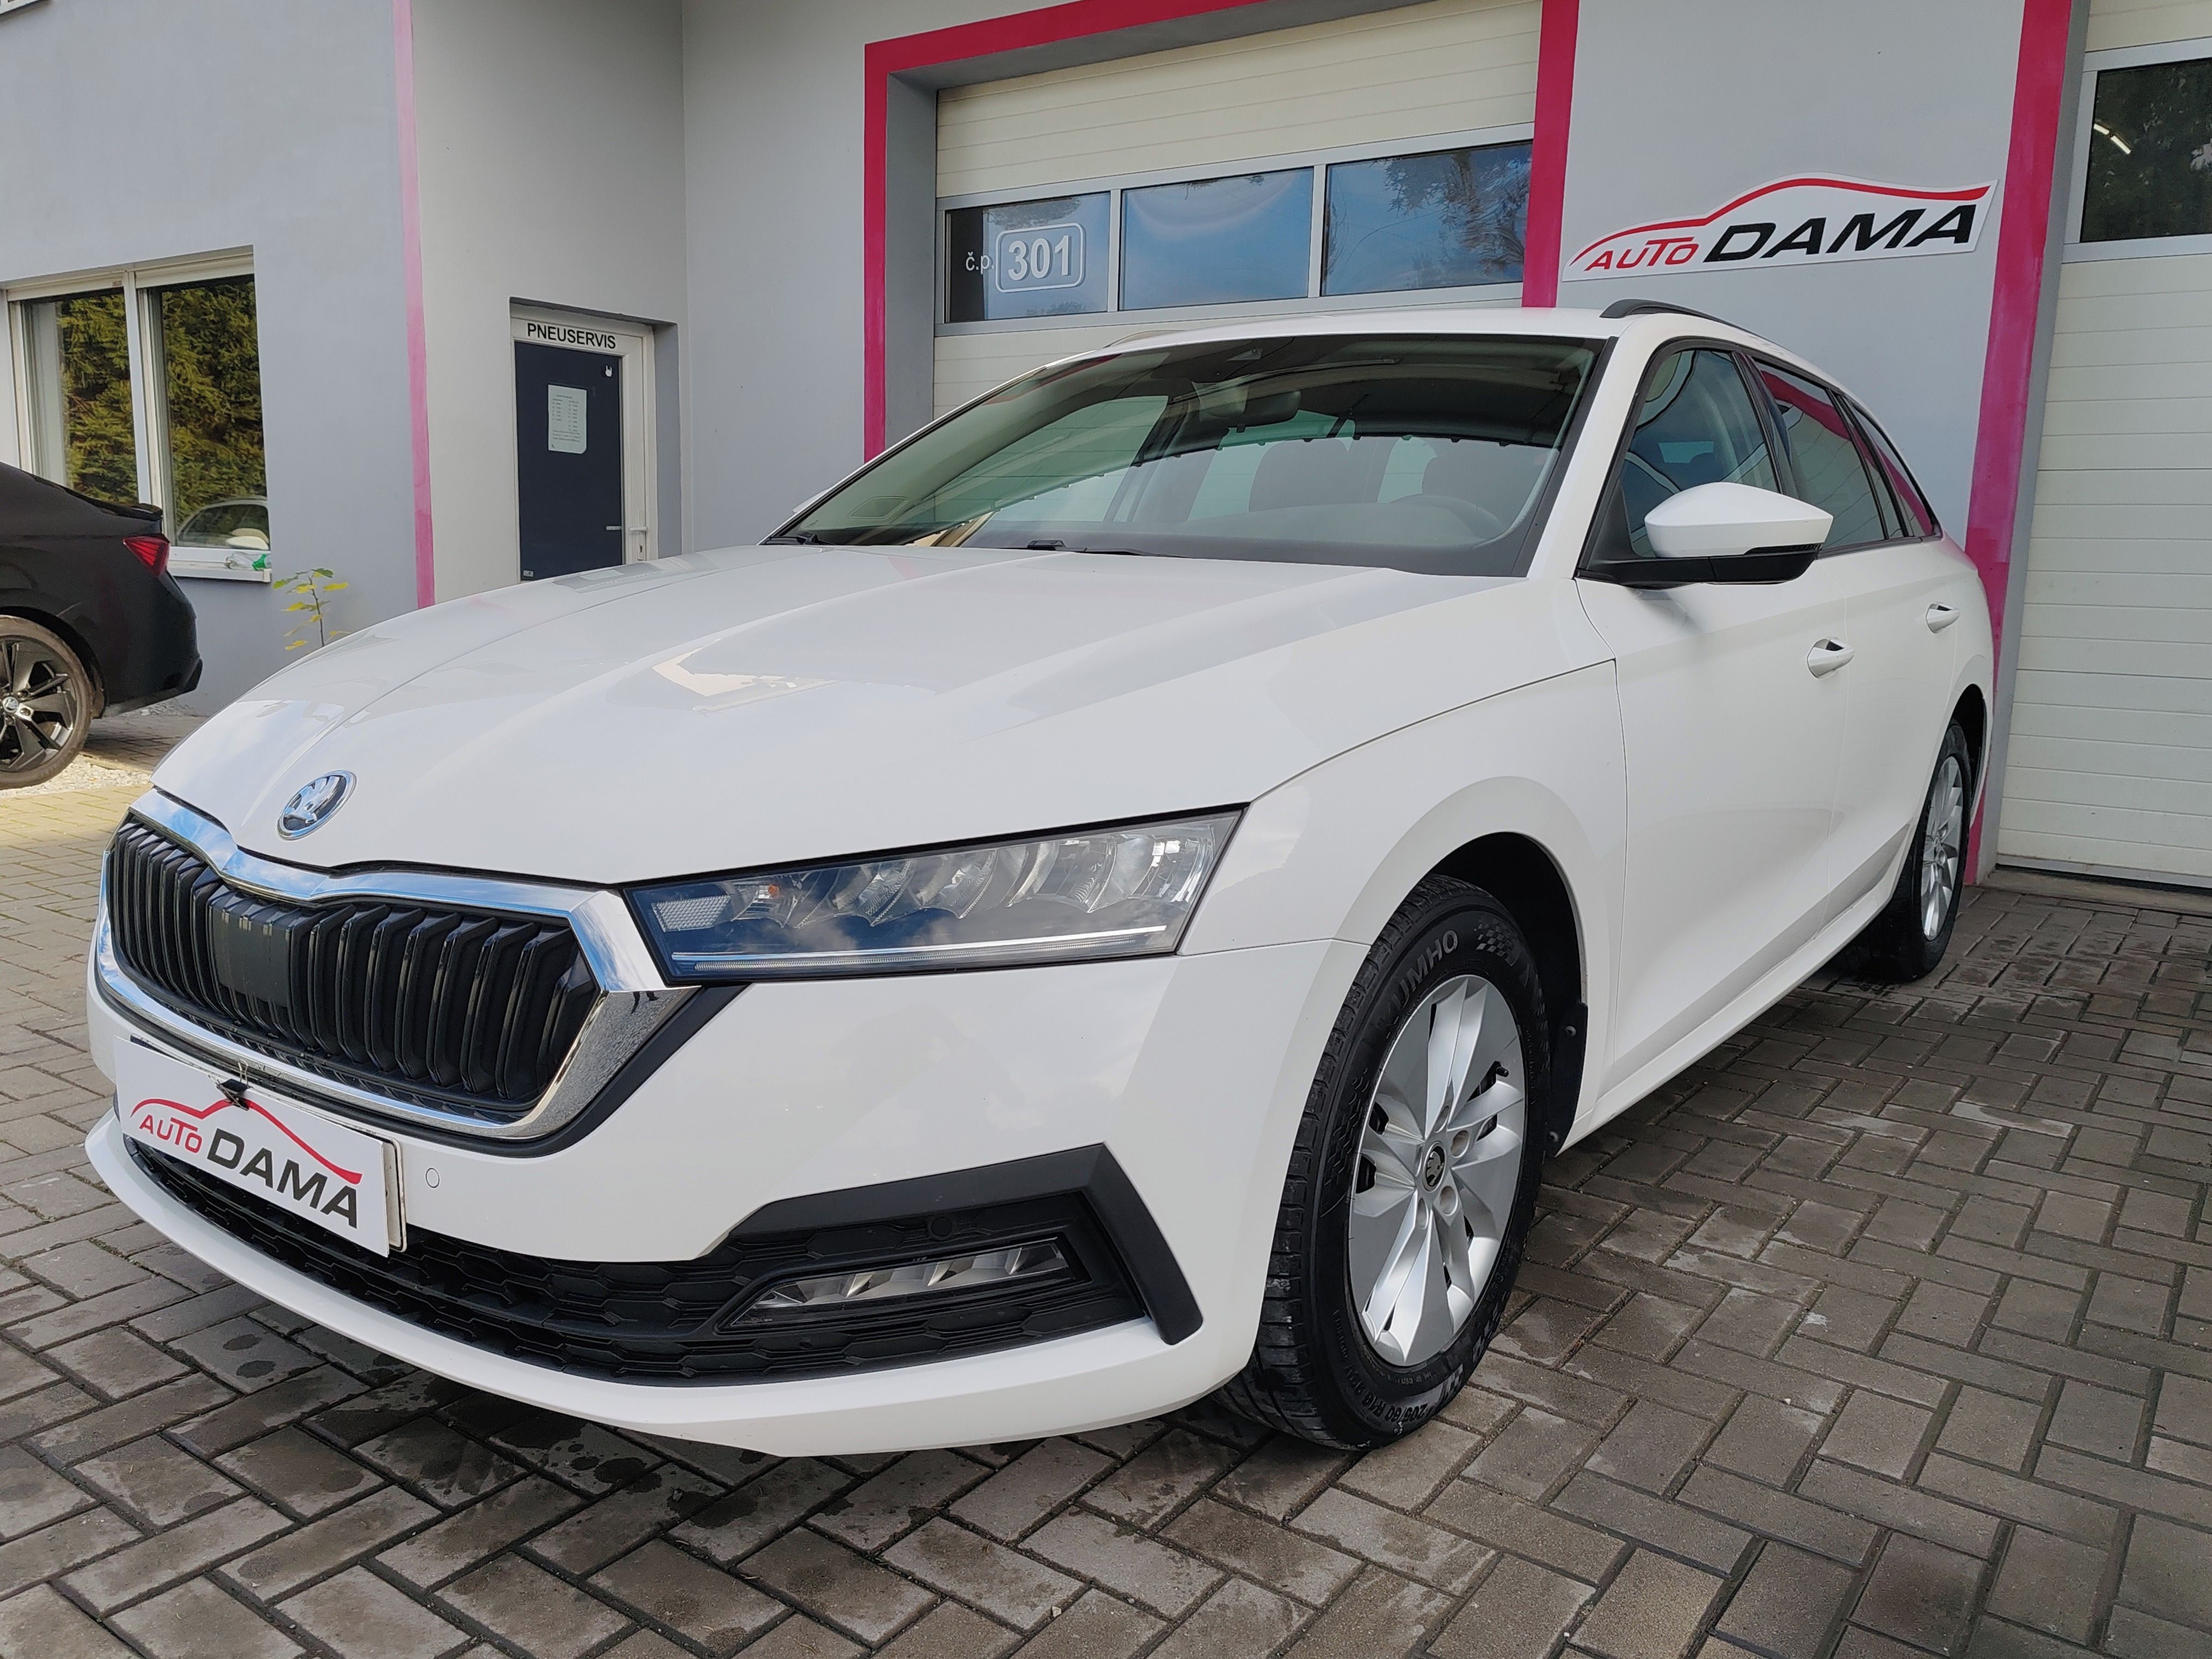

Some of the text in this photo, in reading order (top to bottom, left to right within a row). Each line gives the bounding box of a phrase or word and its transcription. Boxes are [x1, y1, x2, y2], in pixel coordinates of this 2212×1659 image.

[966, 235, 1069, 281] č.p. 301
[1584, 204, 1977, 272] AUTO DAMA
[527, 322, 616, 349] PNEUSERVIS
[1378, 929, 1458, 1040] KUMHO
[139, 1114, 358, 1229] AUTO DAMA
